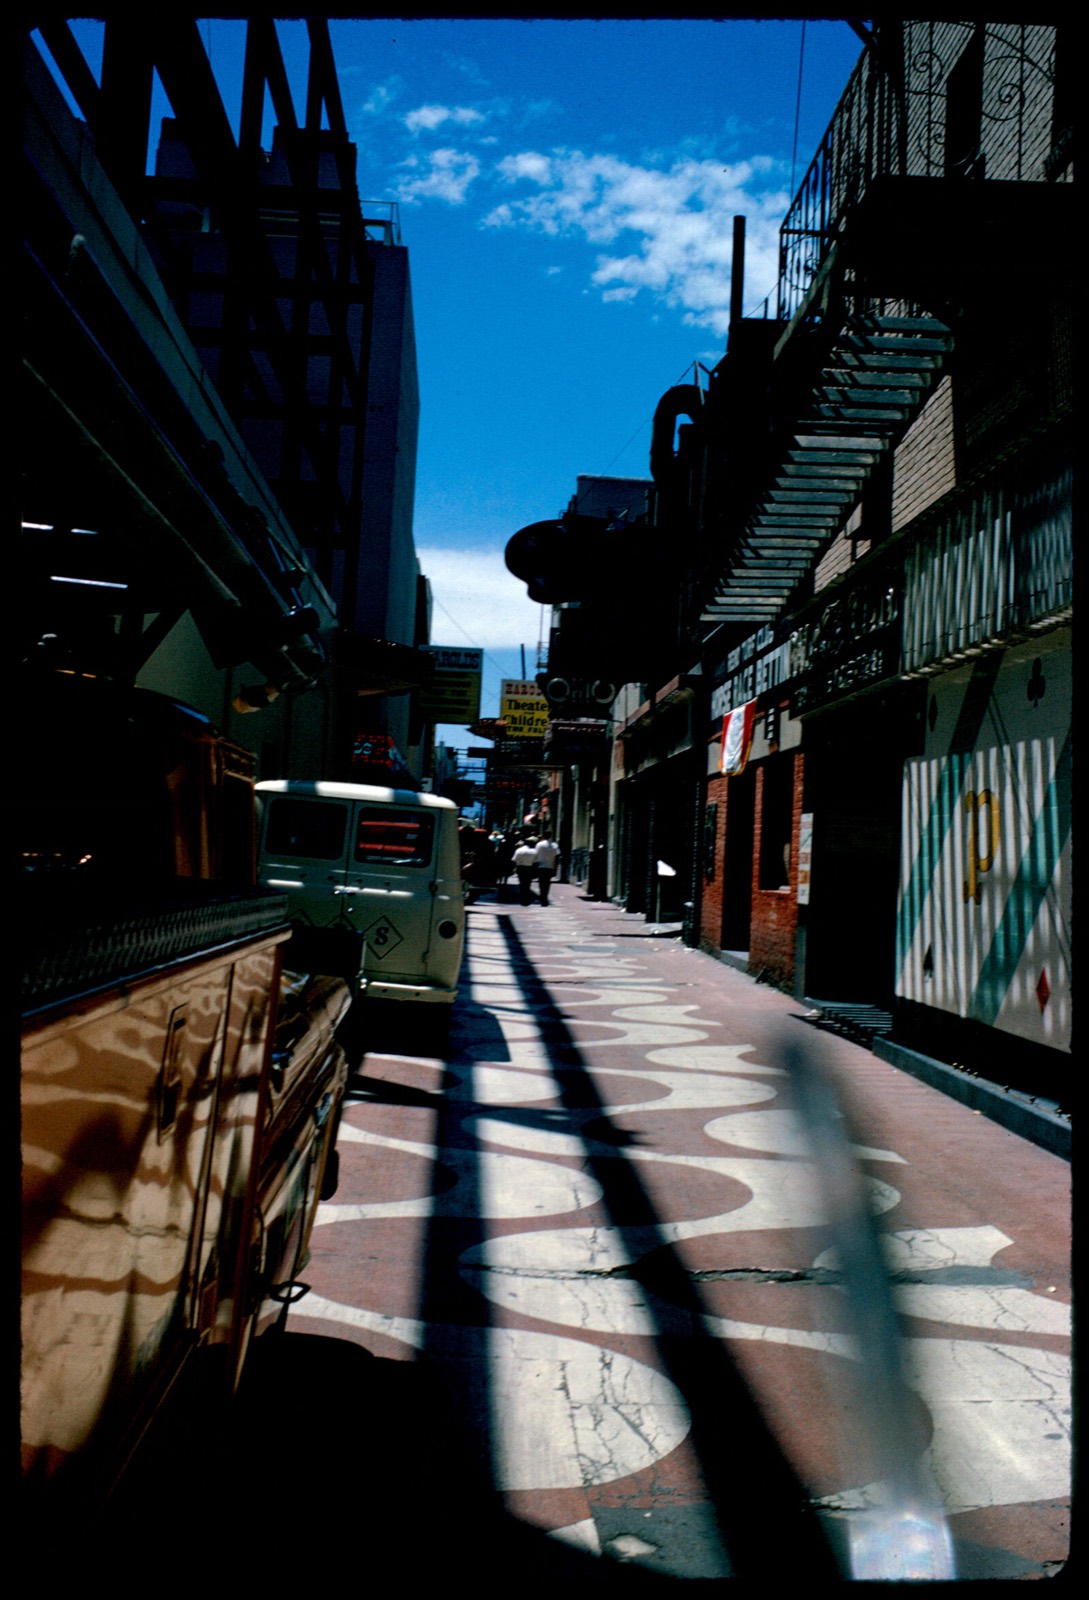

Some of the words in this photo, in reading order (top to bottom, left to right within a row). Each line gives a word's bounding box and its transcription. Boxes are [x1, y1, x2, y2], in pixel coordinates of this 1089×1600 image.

[755, 640, 791, 696] BETTIN
[503, 714, 548, 727] Childre
[374, 926, 389, 945] S
